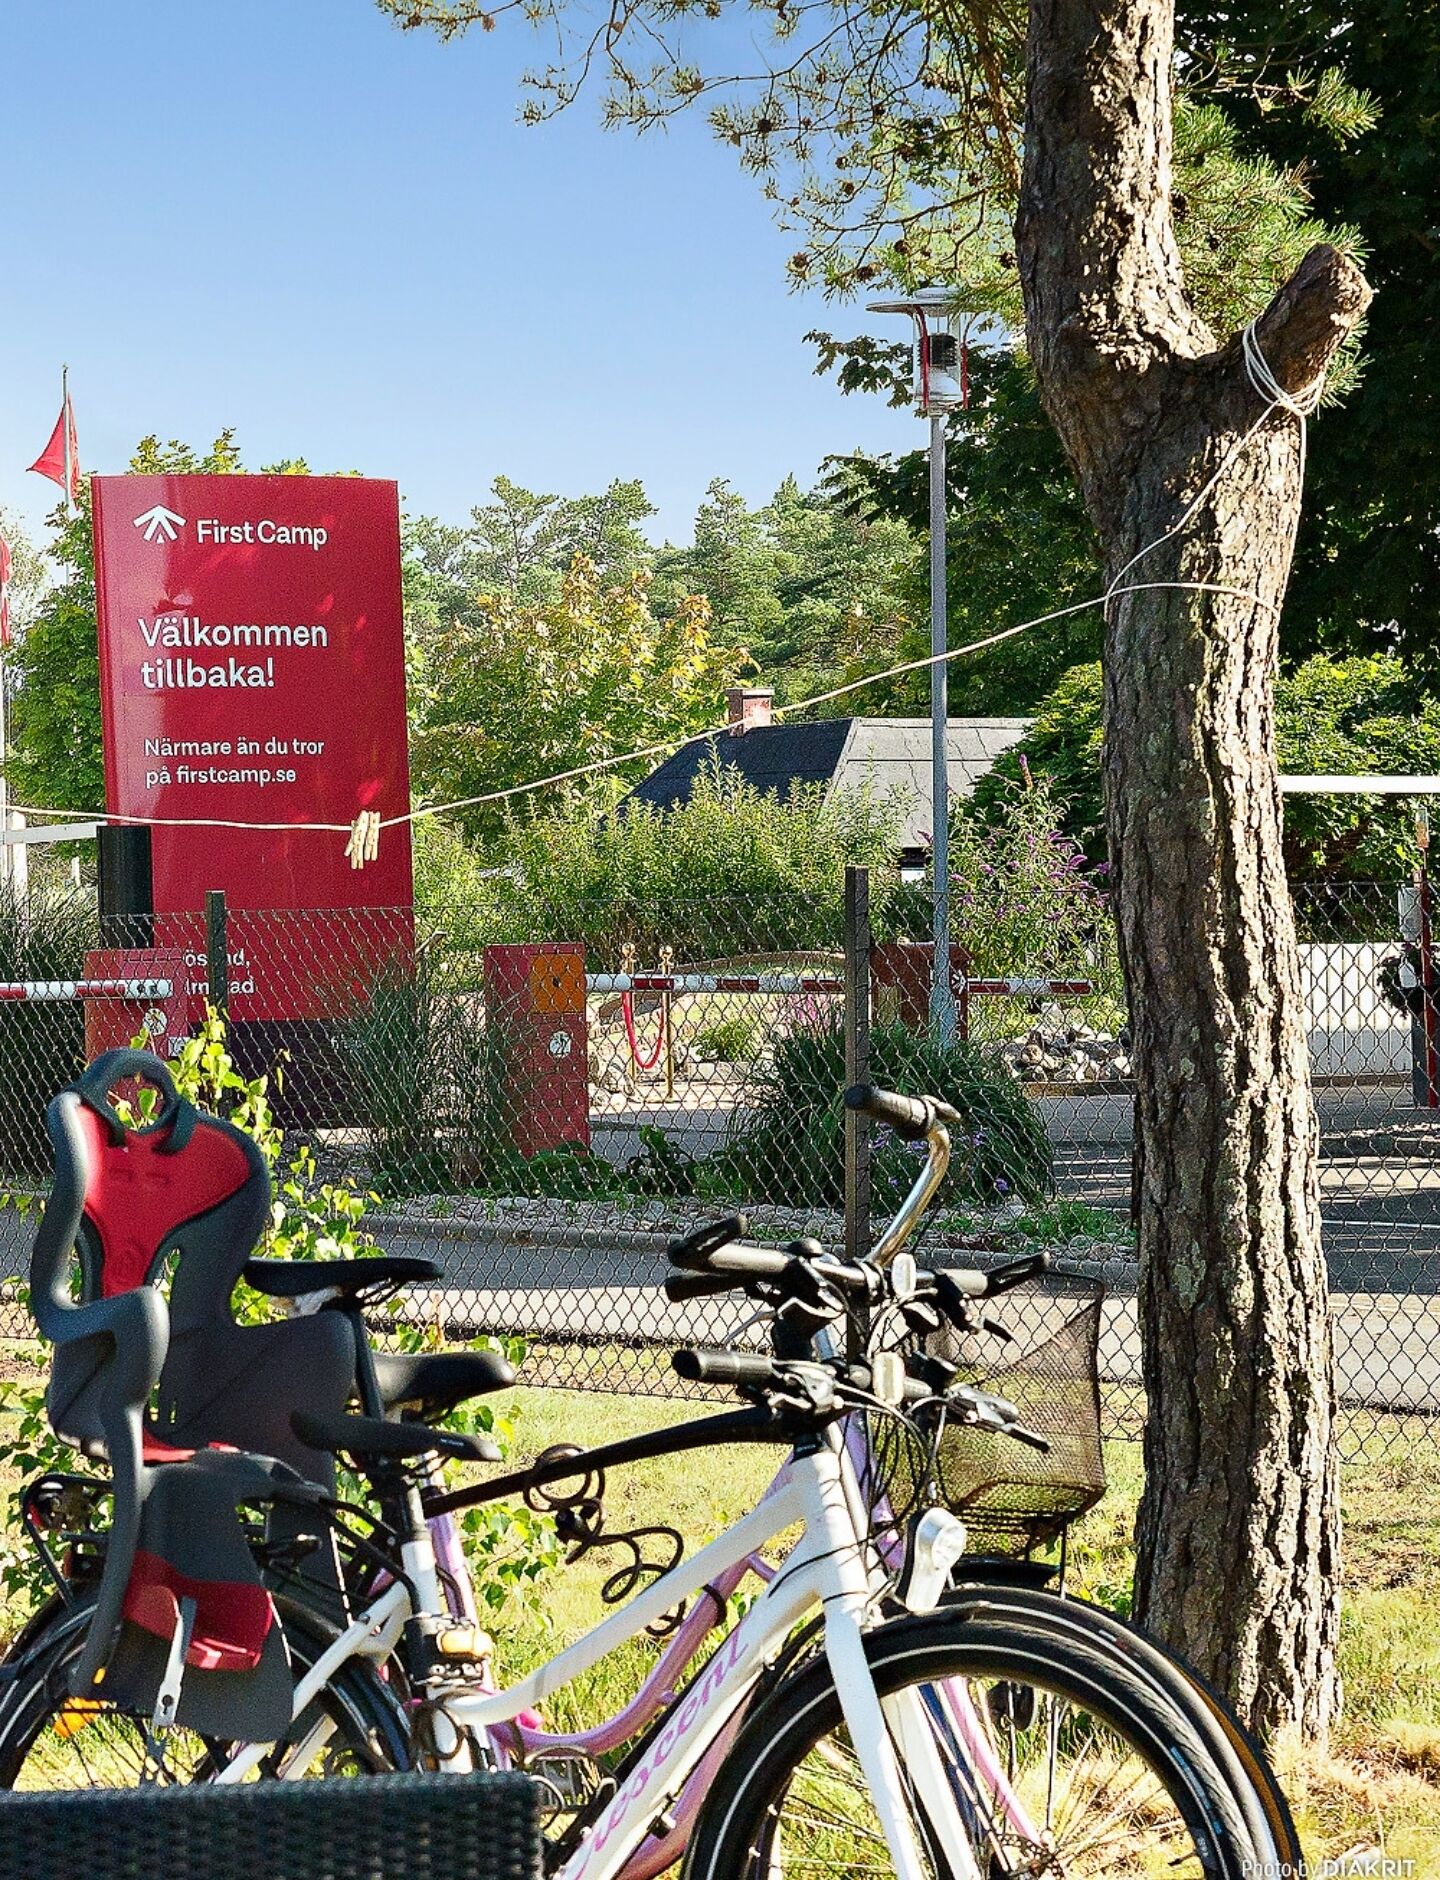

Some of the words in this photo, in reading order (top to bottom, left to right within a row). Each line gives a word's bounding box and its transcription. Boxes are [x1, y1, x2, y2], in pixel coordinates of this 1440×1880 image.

[196, 519, 254, 544] First
[257, 520, 328, 550] Camp
[137, 616, 328, 647] Välkommen
[140, 657, 275, 688] tillbaka!
[144, 738, 232, 757] Närmare
[236, 737, 260, 755] än
[265, 737, 288, 755] du
[293, 738, 325, 755] tror
[146, 766, 171, 789] på
[176, 766, 296, 788] firstcamp.se
